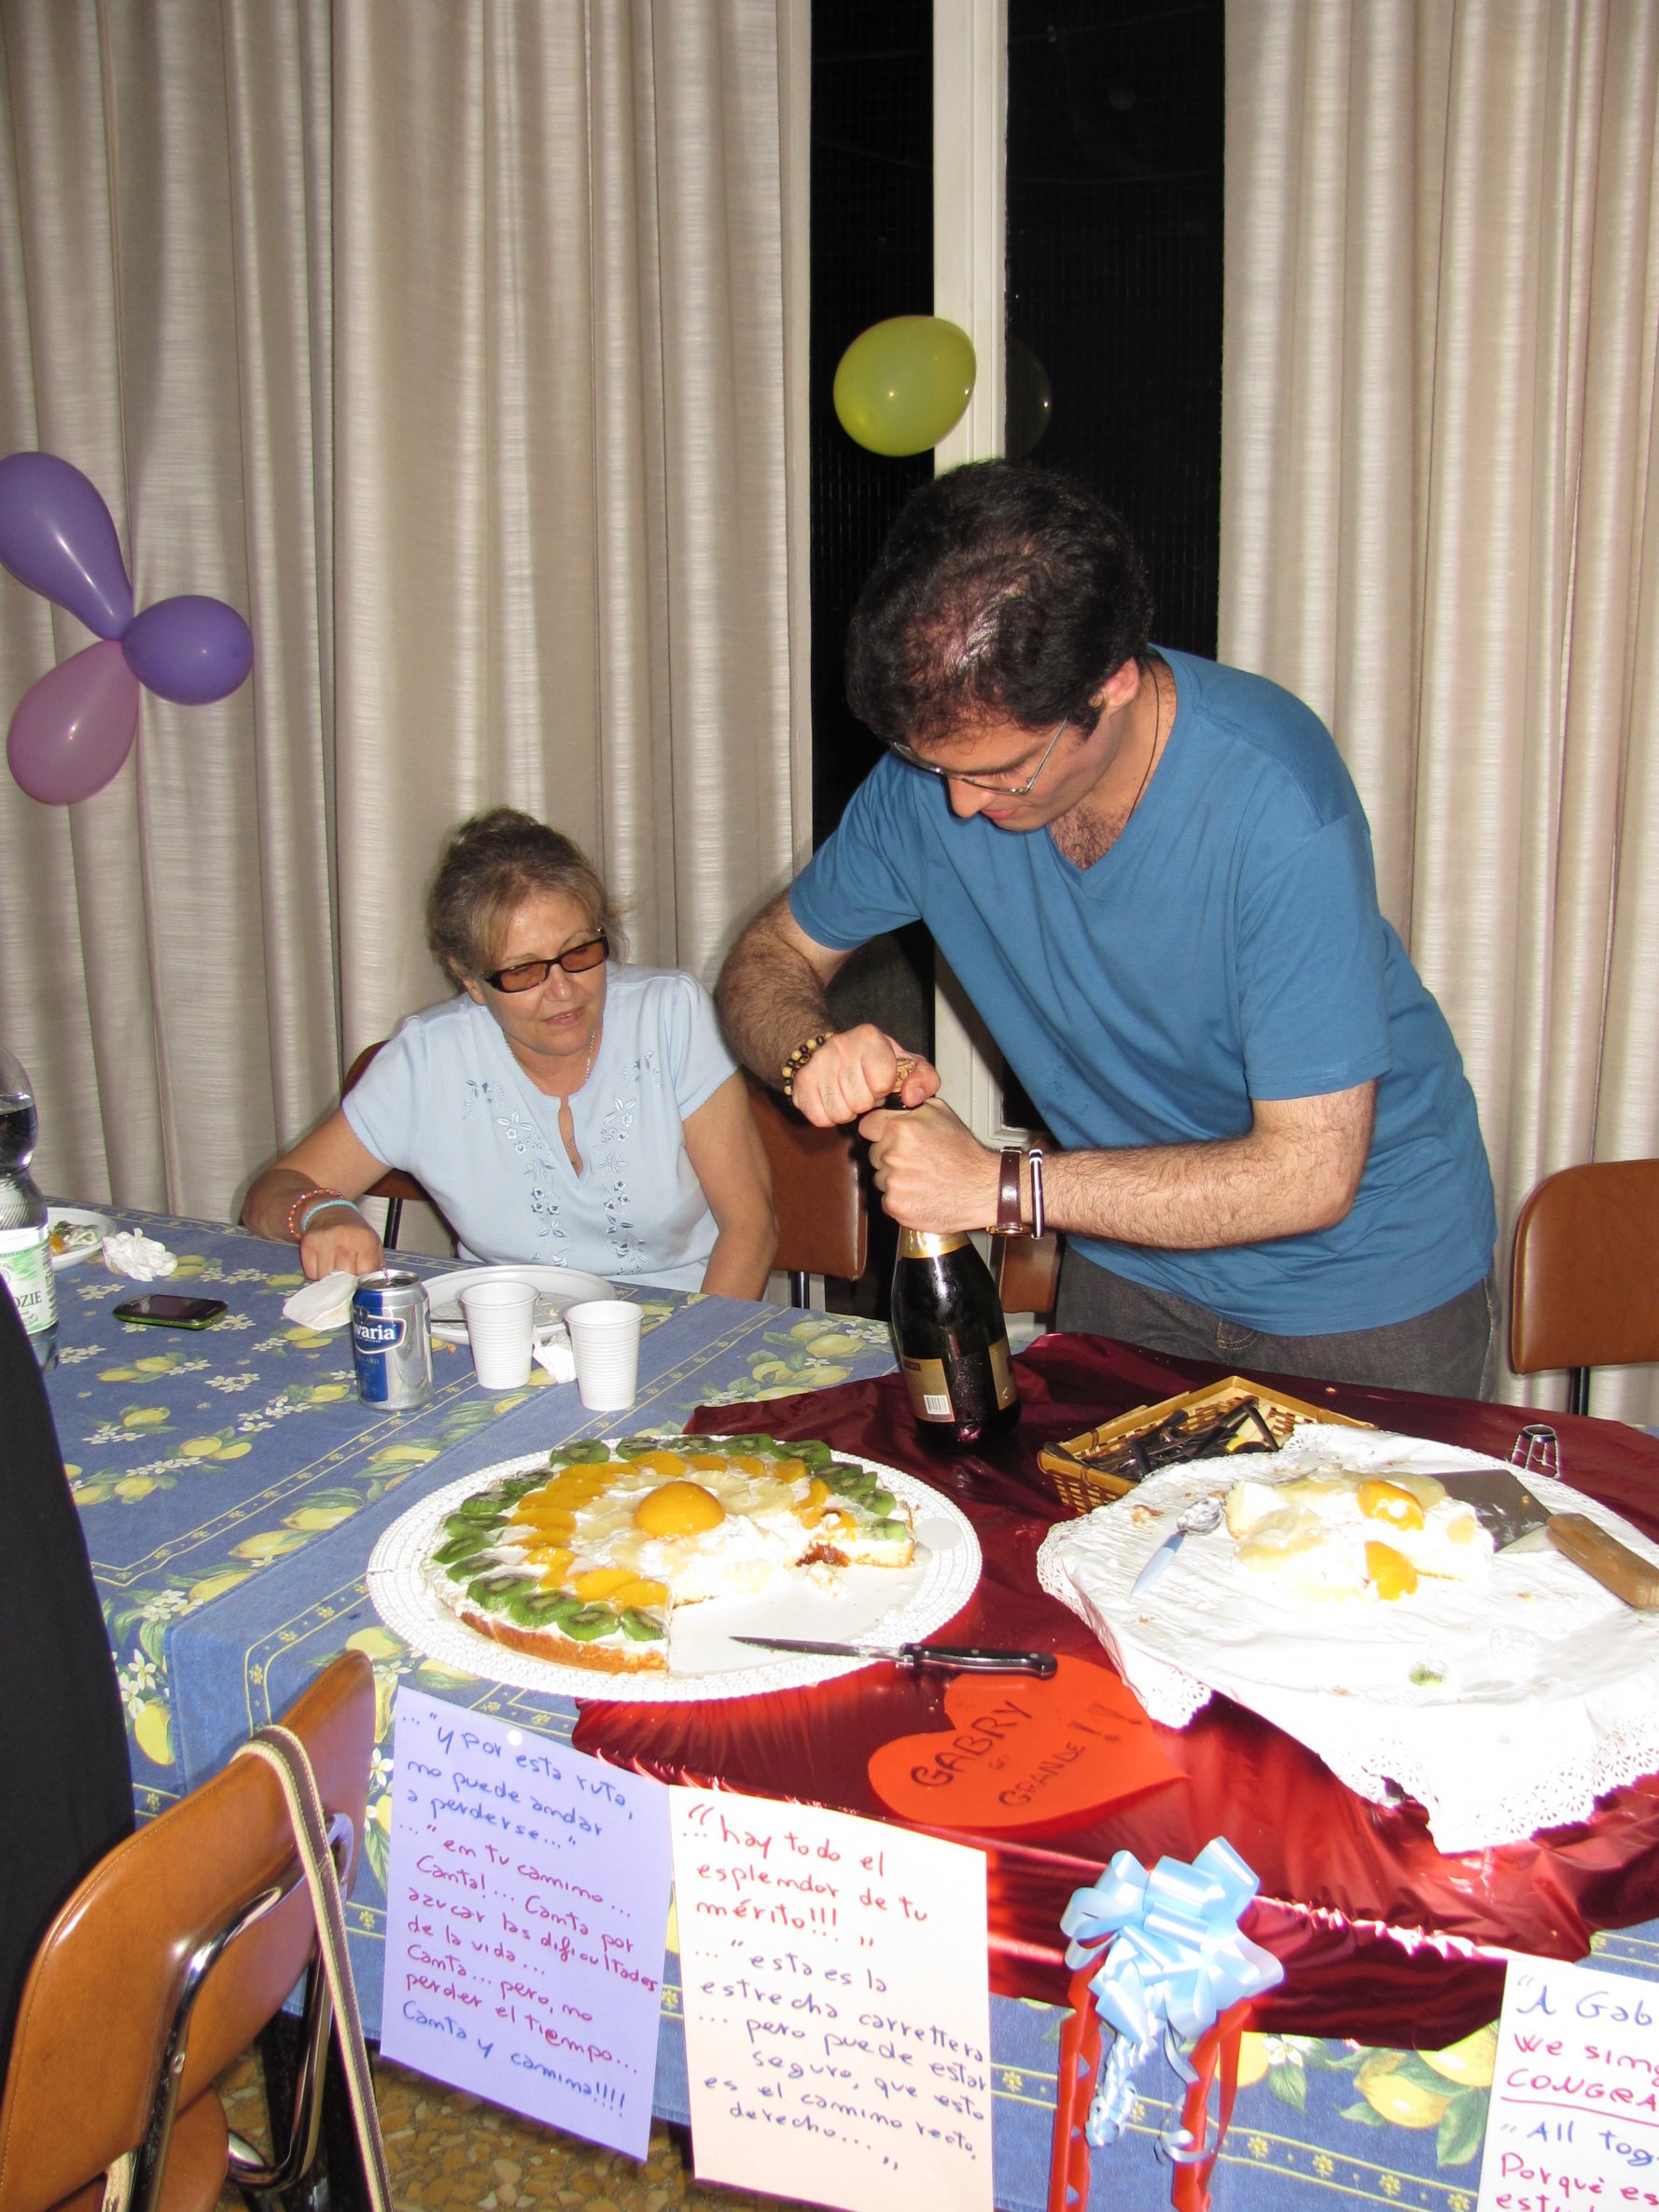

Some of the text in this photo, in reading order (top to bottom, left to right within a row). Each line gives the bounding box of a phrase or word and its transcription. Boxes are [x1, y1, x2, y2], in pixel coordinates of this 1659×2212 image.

[911, 1699, 1033, 1788] GABRY
[516, 1754, 562, 1781] esta
[453, 1772, 521, 1804] puede
[485, 1843, 510, 1867] tu
[859, 1851, 885, 1877] el
[858, 1886, 888, 1912] de
[899, 1895, 928, 1922] tu
[407, 1914, 434, 1937] de
[445, 1925, 462, 1946] la
[601, 1932, 634, 1954] por
[824, 1968, 852, 1984] es
[867, 1968, 887, 1994] la
[406, 1972, 482, 2008] perder
[495, 2005, 516, 2024] el
[700, 1977, 839, 2020] estrecha
[746, 2018, 806, 2044] pero
[824, 2032, 913, 2066] puede
[704, 2076, 738, 2092] es
[758, 2081, 784, 2099] el
[873, 2076, 918, 2100] que
[1598, 2129, 1659, 2167] tog
